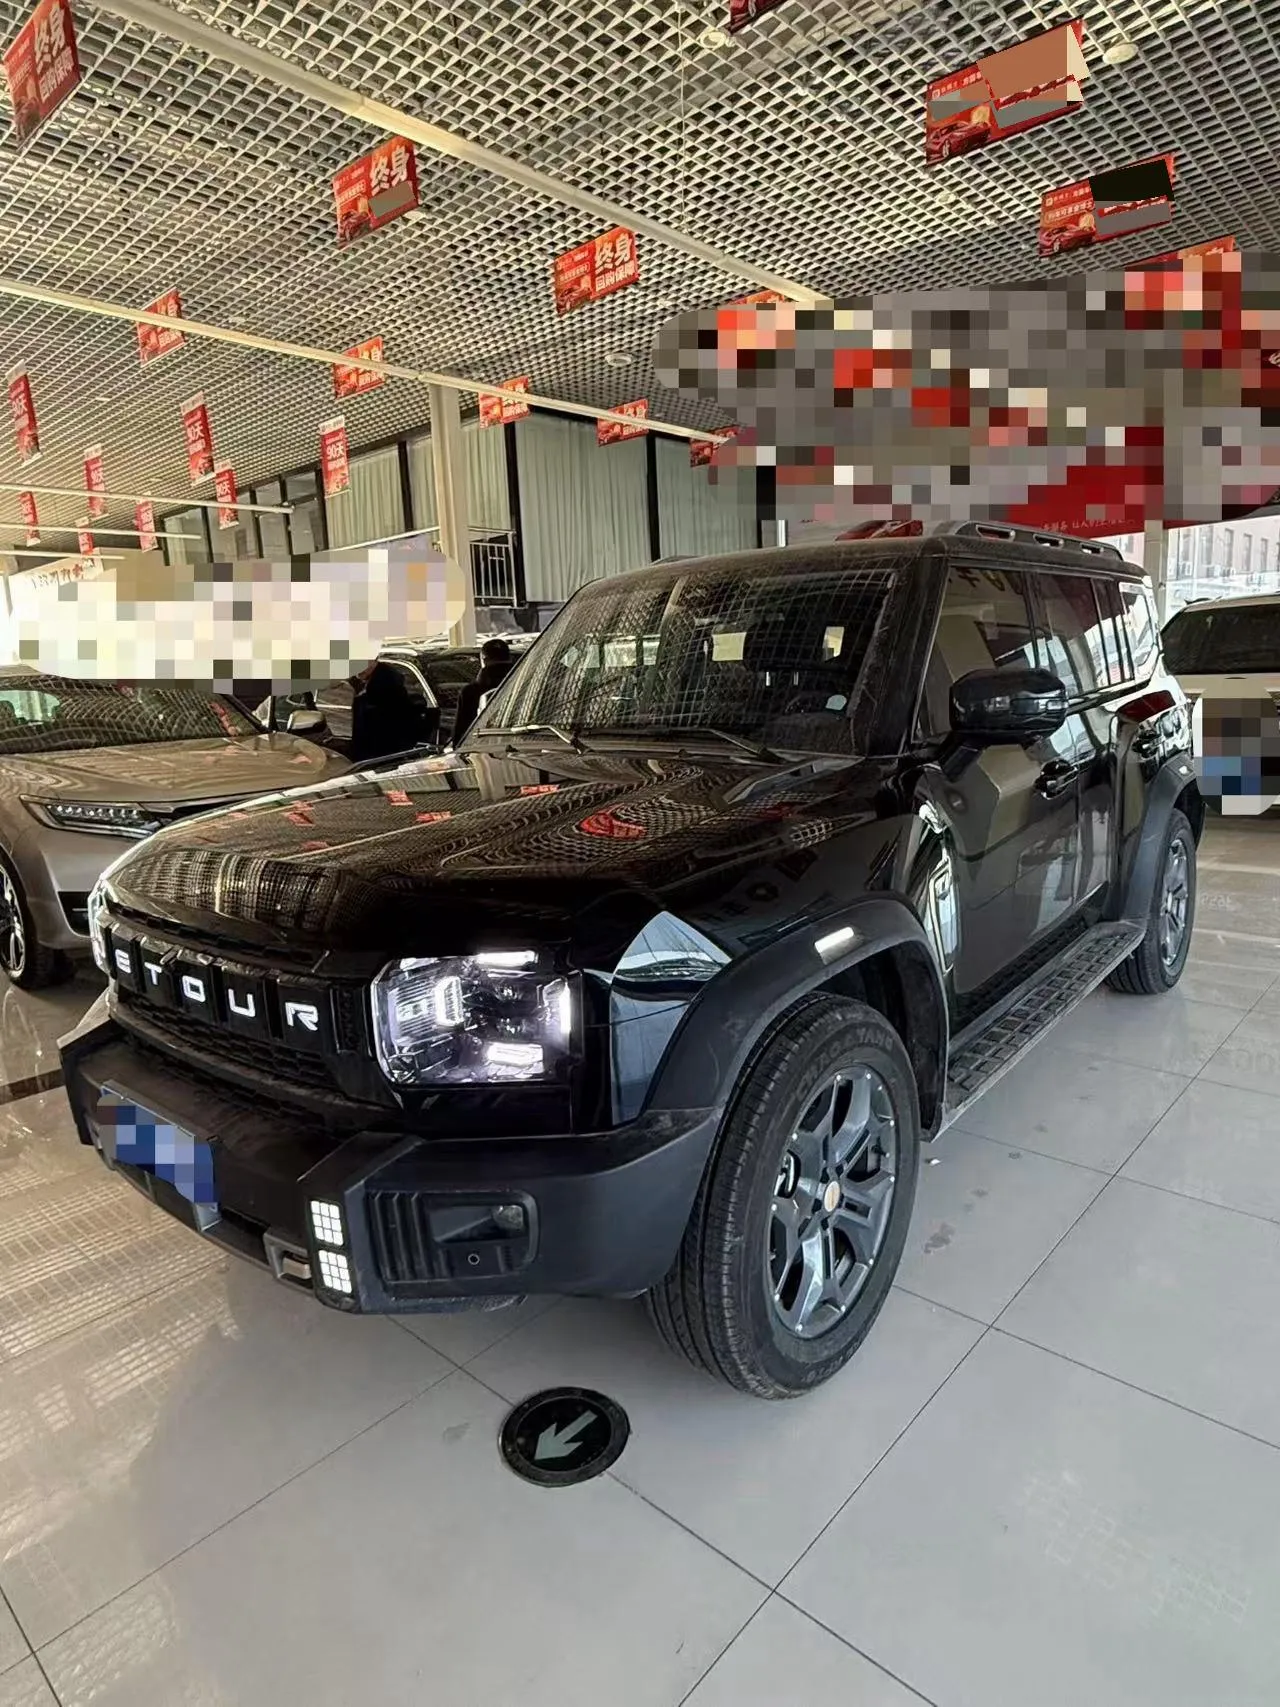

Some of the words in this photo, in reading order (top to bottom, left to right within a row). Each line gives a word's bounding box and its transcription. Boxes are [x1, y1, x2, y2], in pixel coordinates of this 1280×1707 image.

[36, 2, 65, 75] 终身
[370, 145, 409, 196] 终身
[595, 233, 632, 275] 终身
[326, 442, 344, 460] 90天
